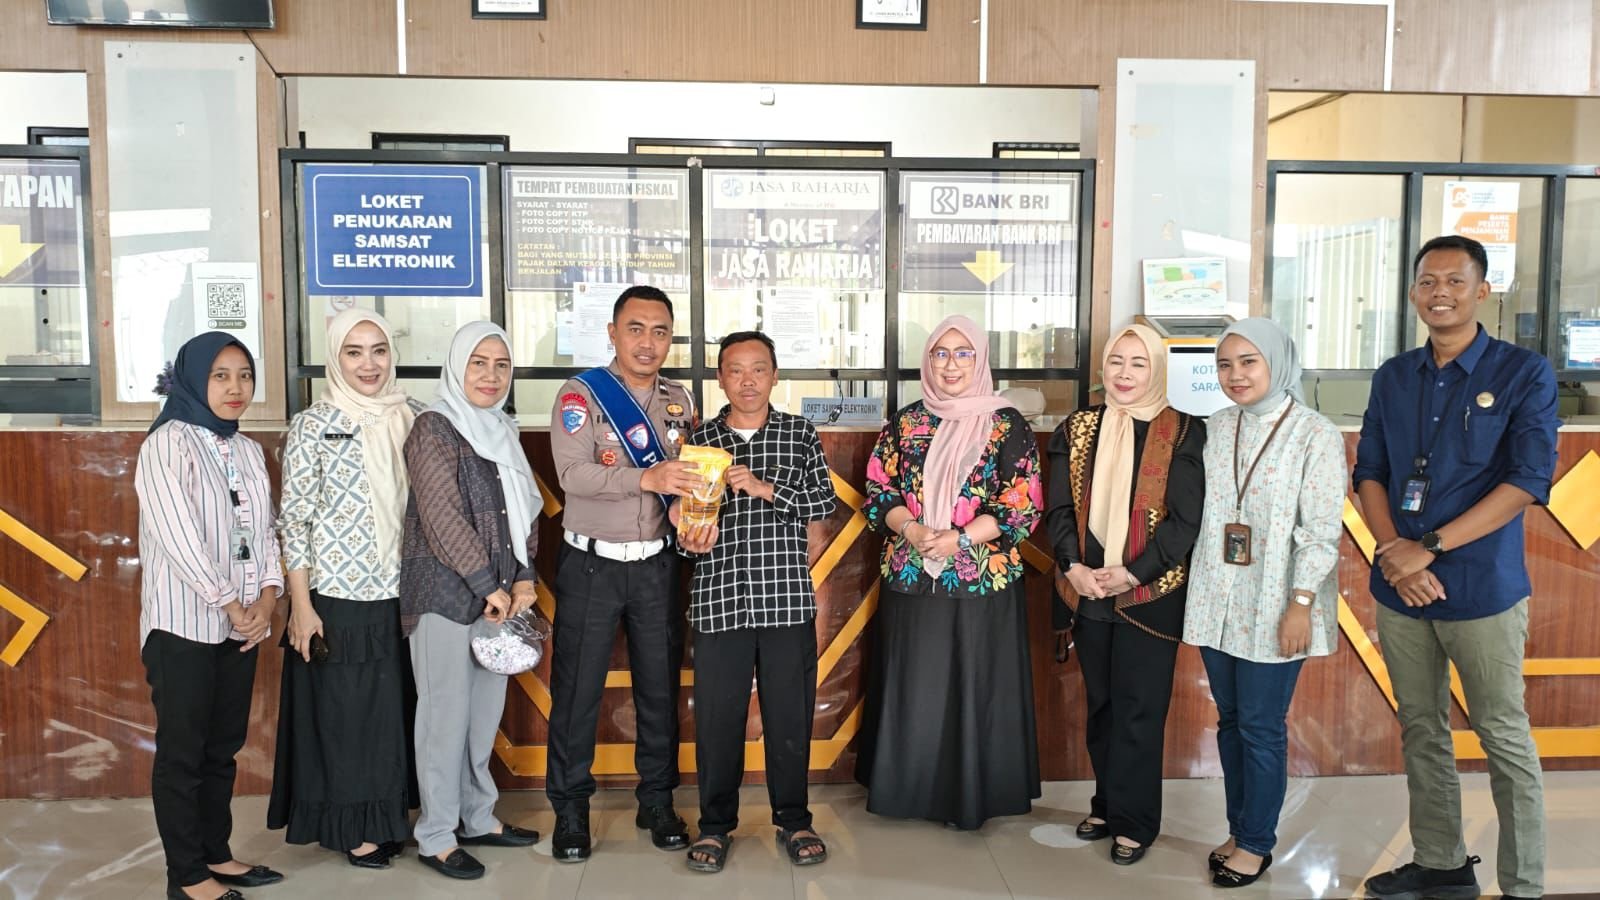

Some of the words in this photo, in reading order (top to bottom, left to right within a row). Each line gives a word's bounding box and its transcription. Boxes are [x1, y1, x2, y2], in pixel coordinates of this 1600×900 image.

[0, 174, 74, 208] APAN
[517, 180, 562, 194] TEMPAT
[564, 181, 633, 195] PEMBUATAN
[636, 182, 675, 196] FISKAL
[748, 180, 786, 195] JASA
[791, 181, 871, 196] RAHARJA
[360, 194, 424, 209] LOKET
[516, 201, 549, 209] SYARAT
[962, 193, 1014, 209] BANK
[1019, 194, 1050, 210] BRI
[333, 214, 453, 228] PENUKARAN
[754, 218, 838, 243] LOKET
[917, 222, 999, 244] PEMBAYARAN
[1001, 223, 1037, 245] BANK
[1038, 224, 1062, 245] BRI
[354, 234, 432, 249] SAMSAT
[332, 254, 456, 268] ELEKTRONIK
[718, 252, 770, 280] JASA
[776, 253, 873, 279] RAHARJA
[1192, 365, 1218, 375] KOT
[803, 403, 821, 413] LOKET
[844, 404, 878, 414] ELEKTRONIK
